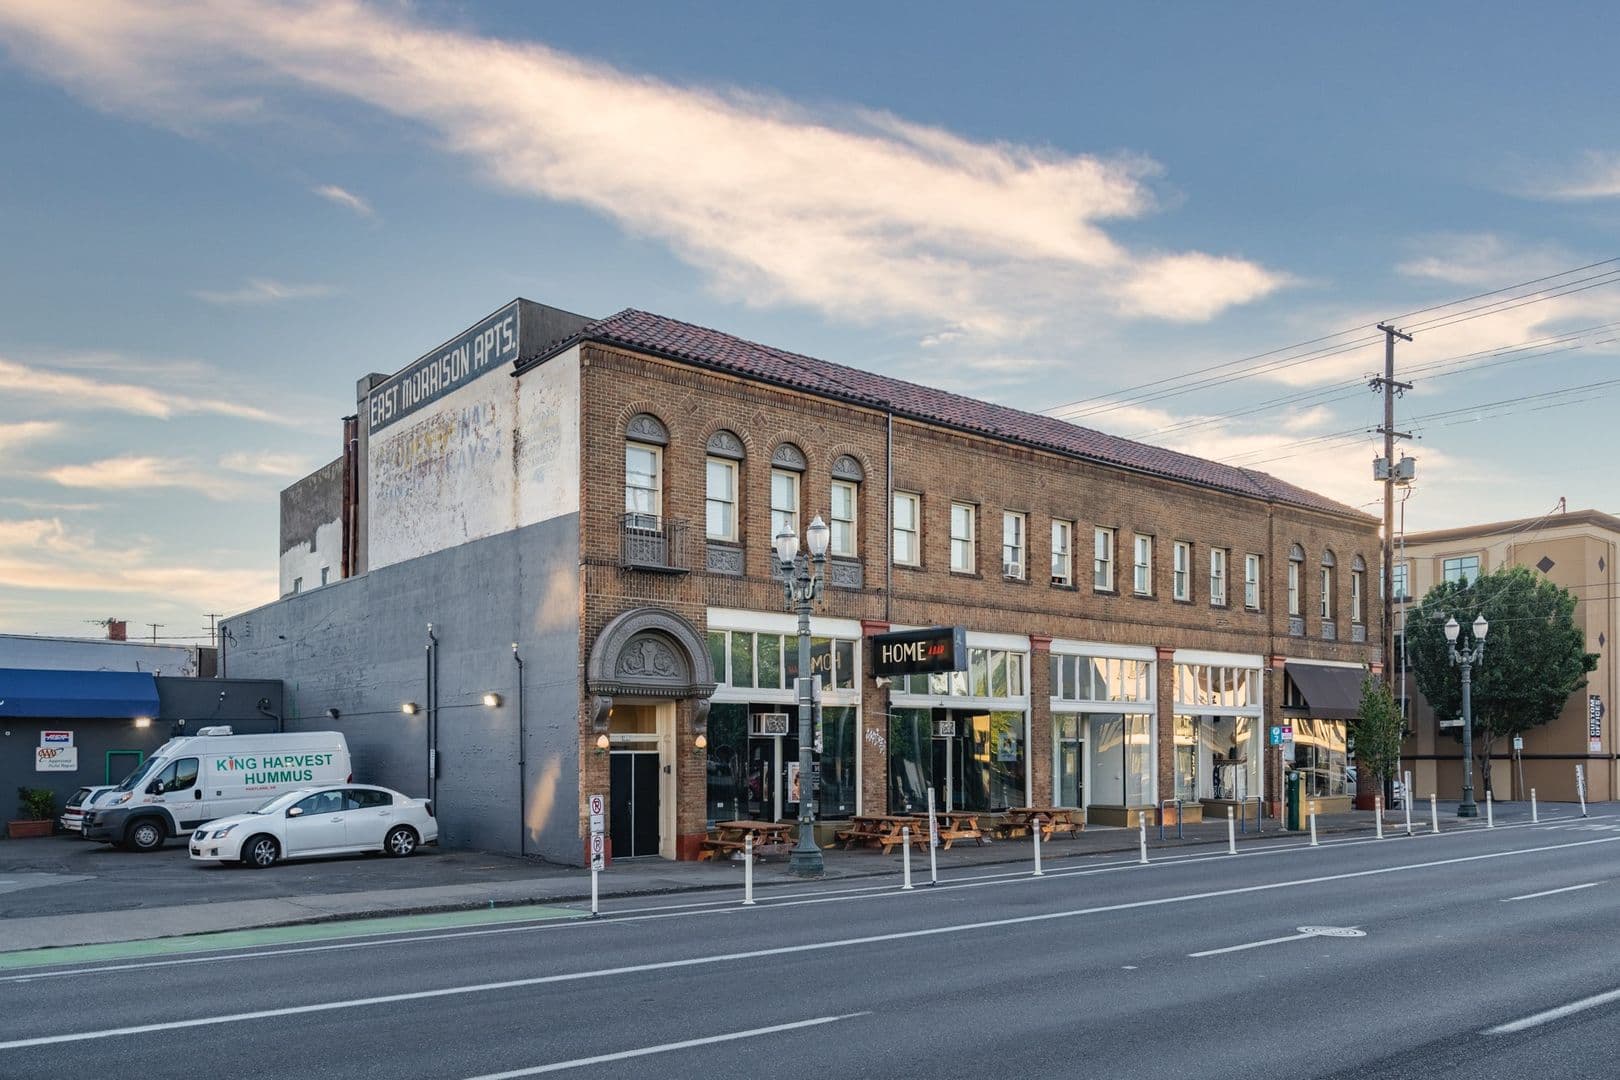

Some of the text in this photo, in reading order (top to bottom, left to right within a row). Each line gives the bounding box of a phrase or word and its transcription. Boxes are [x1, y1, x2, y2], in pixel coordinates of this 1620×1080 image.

[371, 317, 516, 427] EAST MORRISON APTS.
[882, 641, 927, 664] HOME
[216, 754, 332, 771] KING HARVEST
[244, 770, 313, 785] HUMMUS
